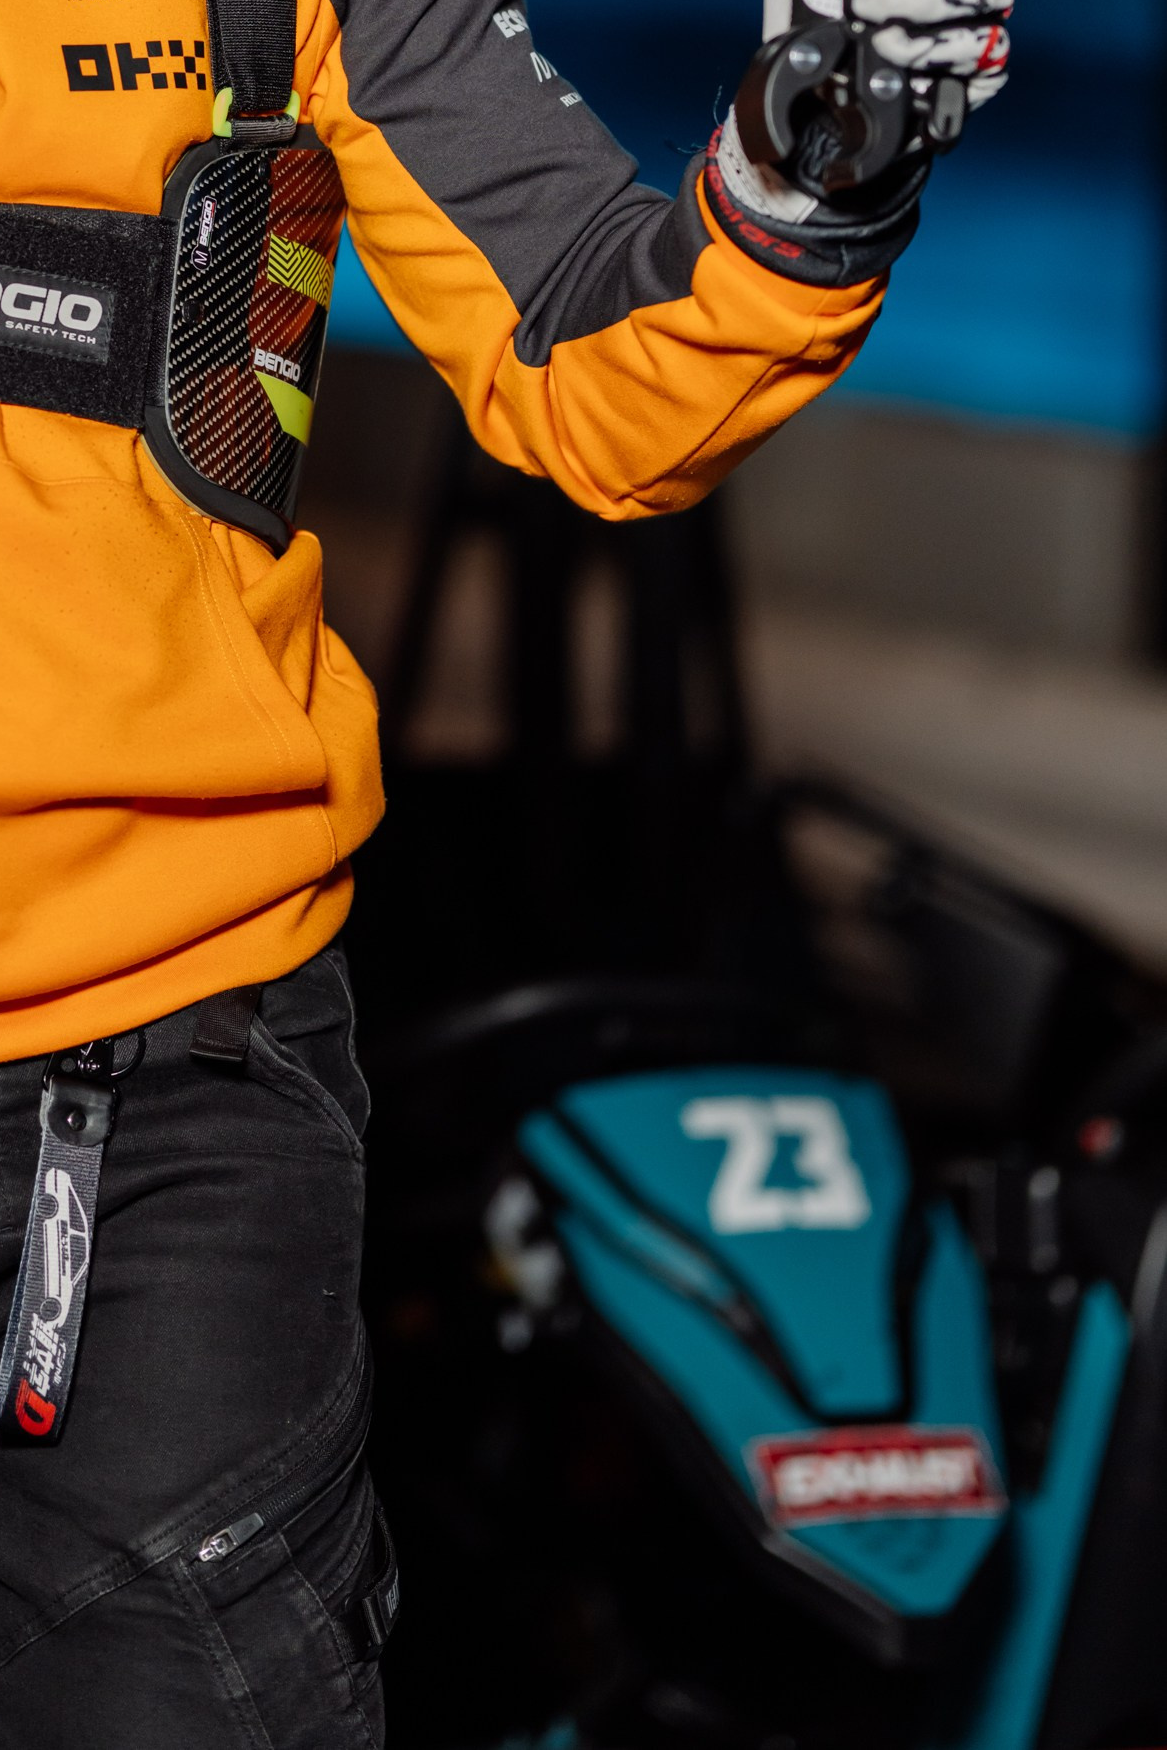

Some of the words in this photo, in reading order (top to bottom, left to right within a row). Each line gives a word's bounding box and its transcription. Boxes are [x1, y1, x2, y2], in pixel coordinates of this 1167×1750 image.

[199, 200, 213, 247] BENGIO
[194, 250, 209, 266] M
[5, 320, 59, 338] SAFETY
[61, 330, 97, 345] TECH
[254, 348, 302, 382] BENGIO
[680, 1094, 872, 1235] 23
